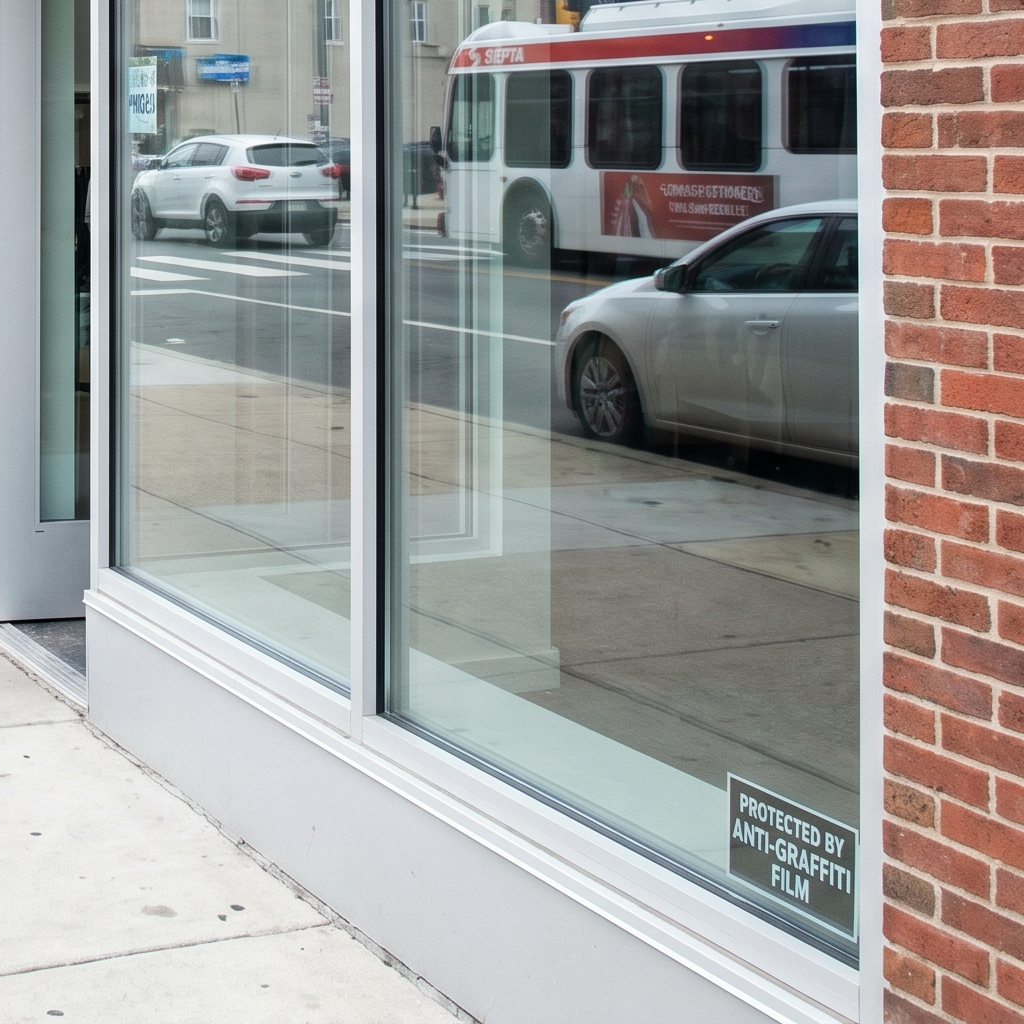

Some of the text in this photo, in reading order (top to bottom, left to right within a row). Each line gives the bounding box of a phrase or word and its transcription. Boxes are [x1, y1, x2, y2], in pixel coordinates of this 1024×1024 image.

[484, 47, 525, 65] SEPTA
[739, 792, 845, 858] PROTECTED BY
[732, 817, 851, 894] ANTI-GRAFFITI
[771, 863, 809, 904] FILM
